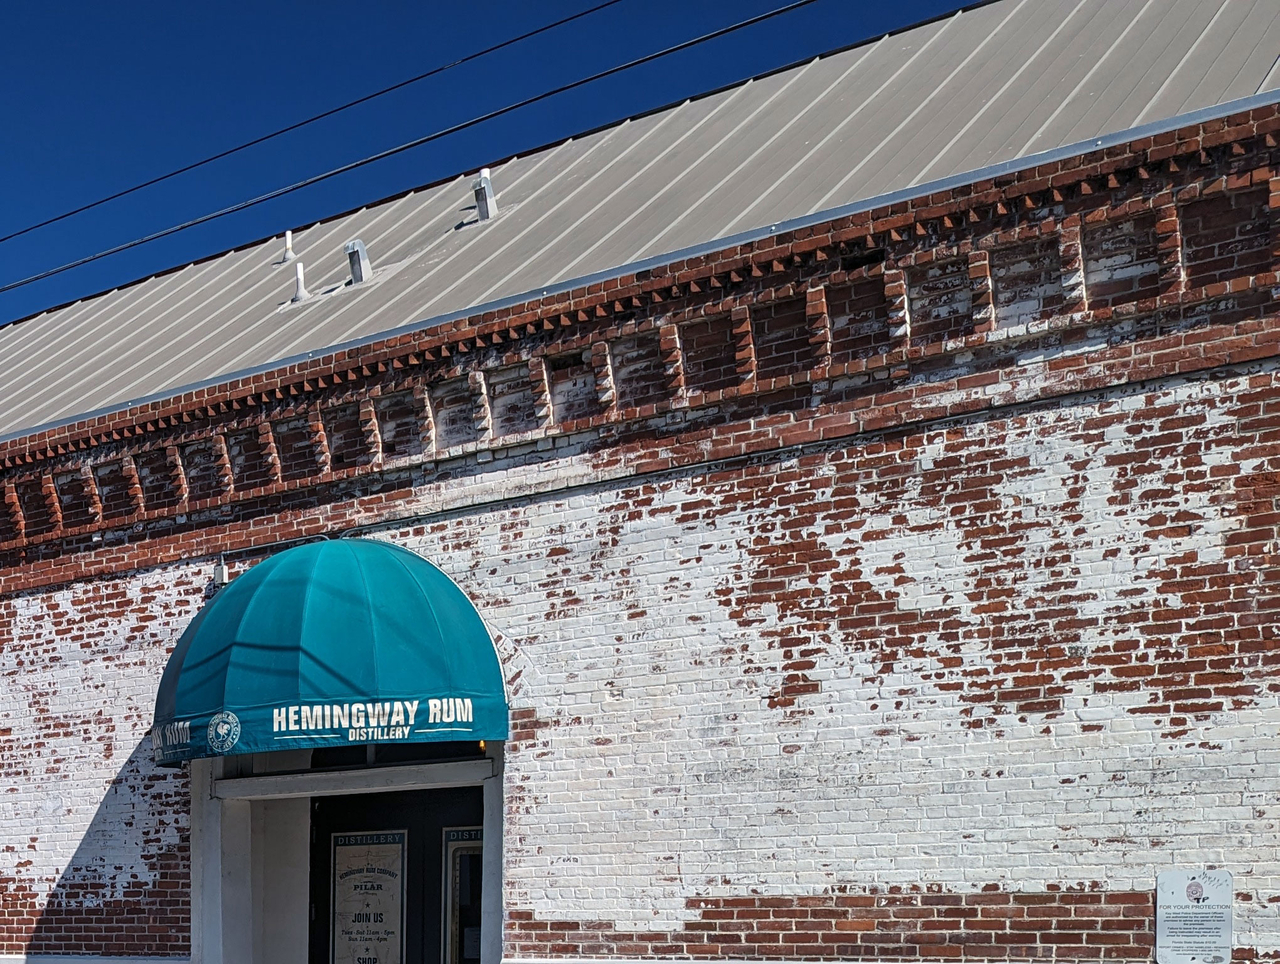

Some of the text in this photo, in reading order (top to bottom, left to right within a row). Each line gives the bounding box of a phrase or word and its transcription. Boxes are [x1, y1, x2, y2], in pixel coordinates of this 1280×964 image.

[273, 698, 473, 732] HEMINGWAY RUM
[164, 722, 190, 746] RUM
[348, 726, 410, 742] DISTILLERY
[338, 834, 400, 844] DISTILLERY
[376, 868, 398, 880] COMPANY
[352, 913, 384, 923] JOIN US
